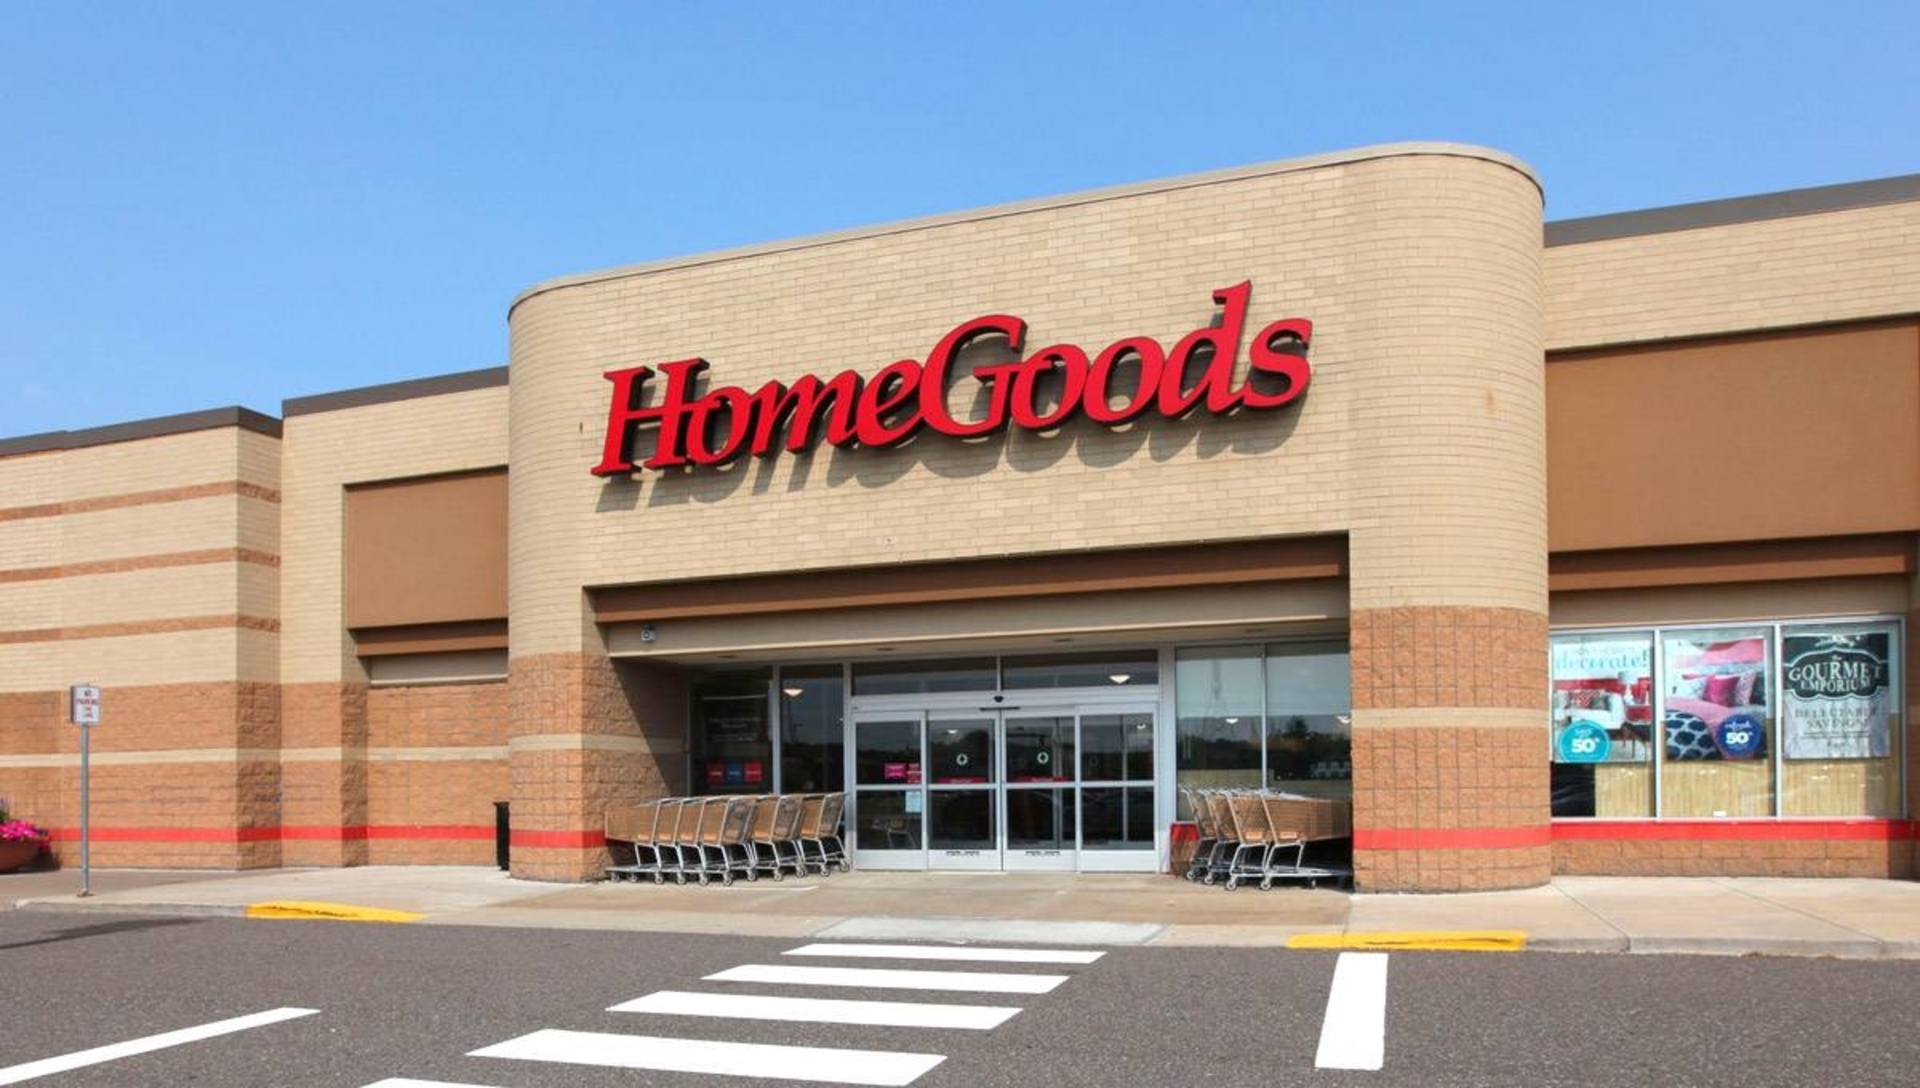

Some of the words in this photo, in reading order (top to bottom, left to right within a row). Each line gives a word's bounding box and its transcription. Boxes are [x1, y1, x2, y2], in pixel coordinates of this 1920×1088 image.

[591, 282, 1312, 475] HomeGoods
[1788, 660, 1881, 682] GOURMET
[1800, 678, 1871, 693] EMPORIUM
